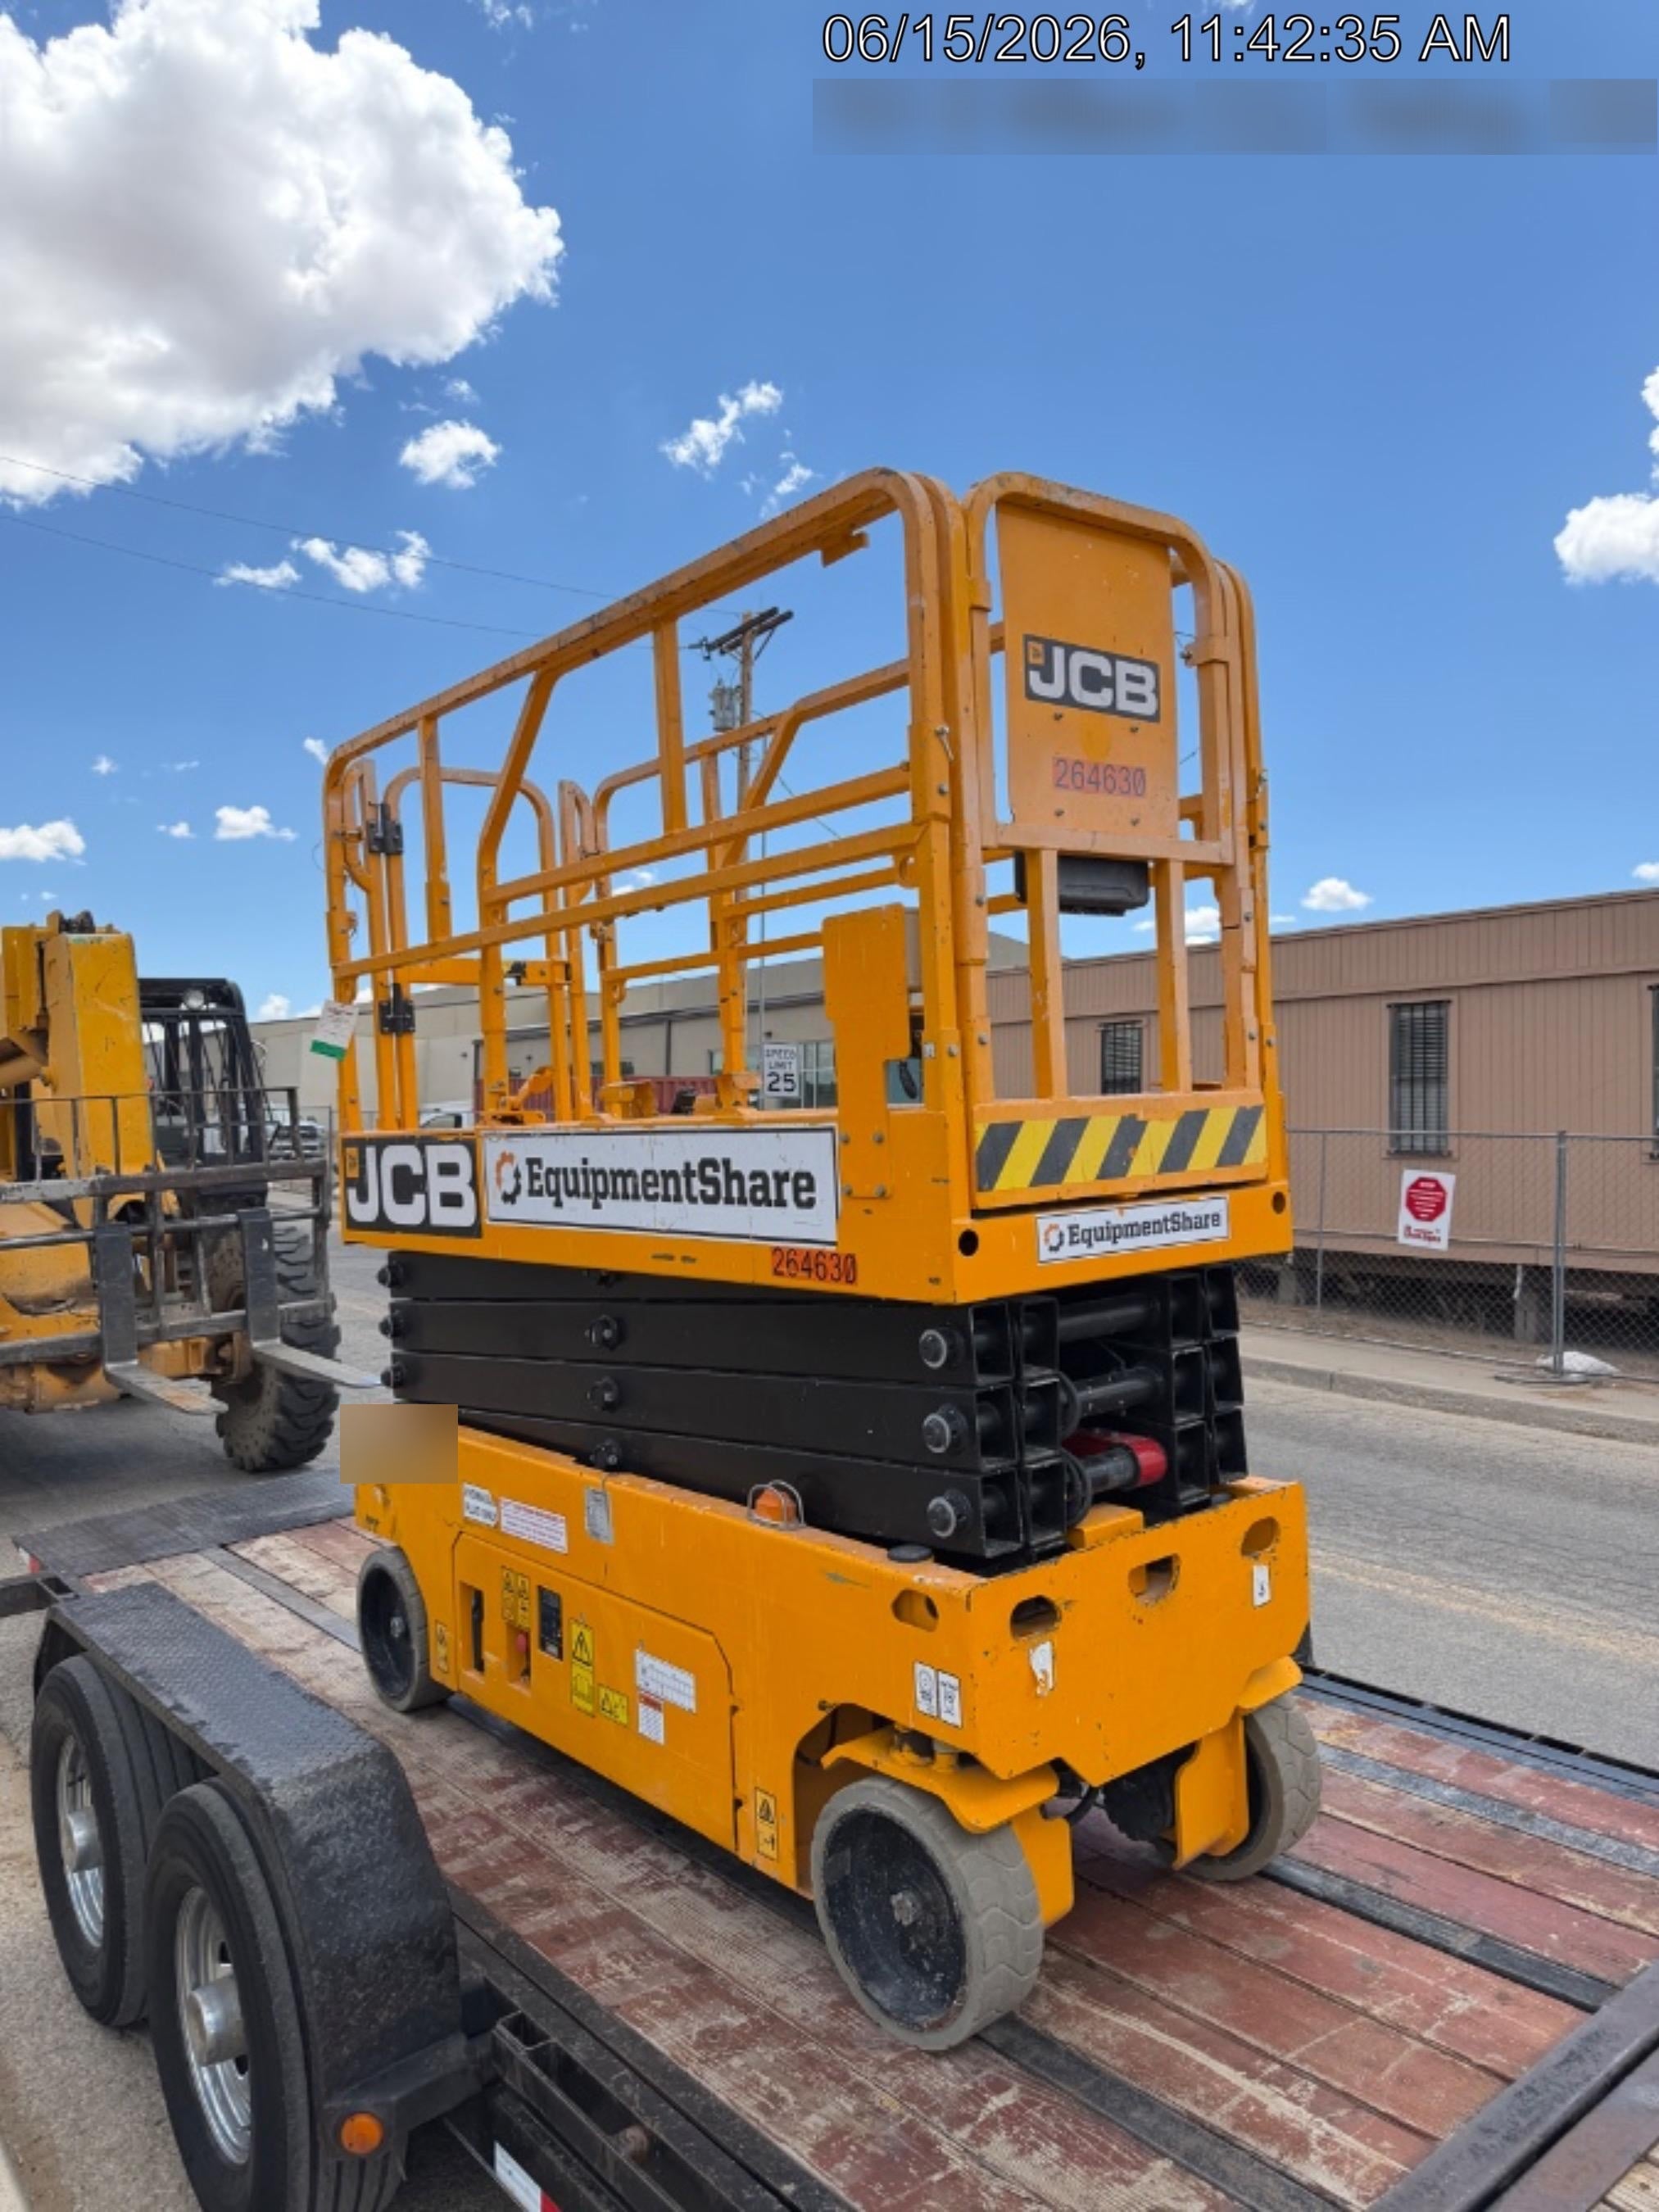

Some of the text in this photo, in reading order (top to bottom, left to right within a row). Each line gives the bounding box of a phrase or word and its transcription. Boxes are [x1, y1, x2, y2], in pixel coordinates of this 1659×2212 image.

[1029, 646, 1158, 716] JCB
[1055, 759, 1145, 796] 264630
[767, 1072, 796, 1092] 25
[768, 1061, 793, 1070] LIMIT
[347, 1145, 477, 1227] JCB
[525, 1157, 816, 1210] EquipmentShare
[1067, 1211, 1221, 1249] EquipmentShare
[772, 1247, 858, 1285] 264630
